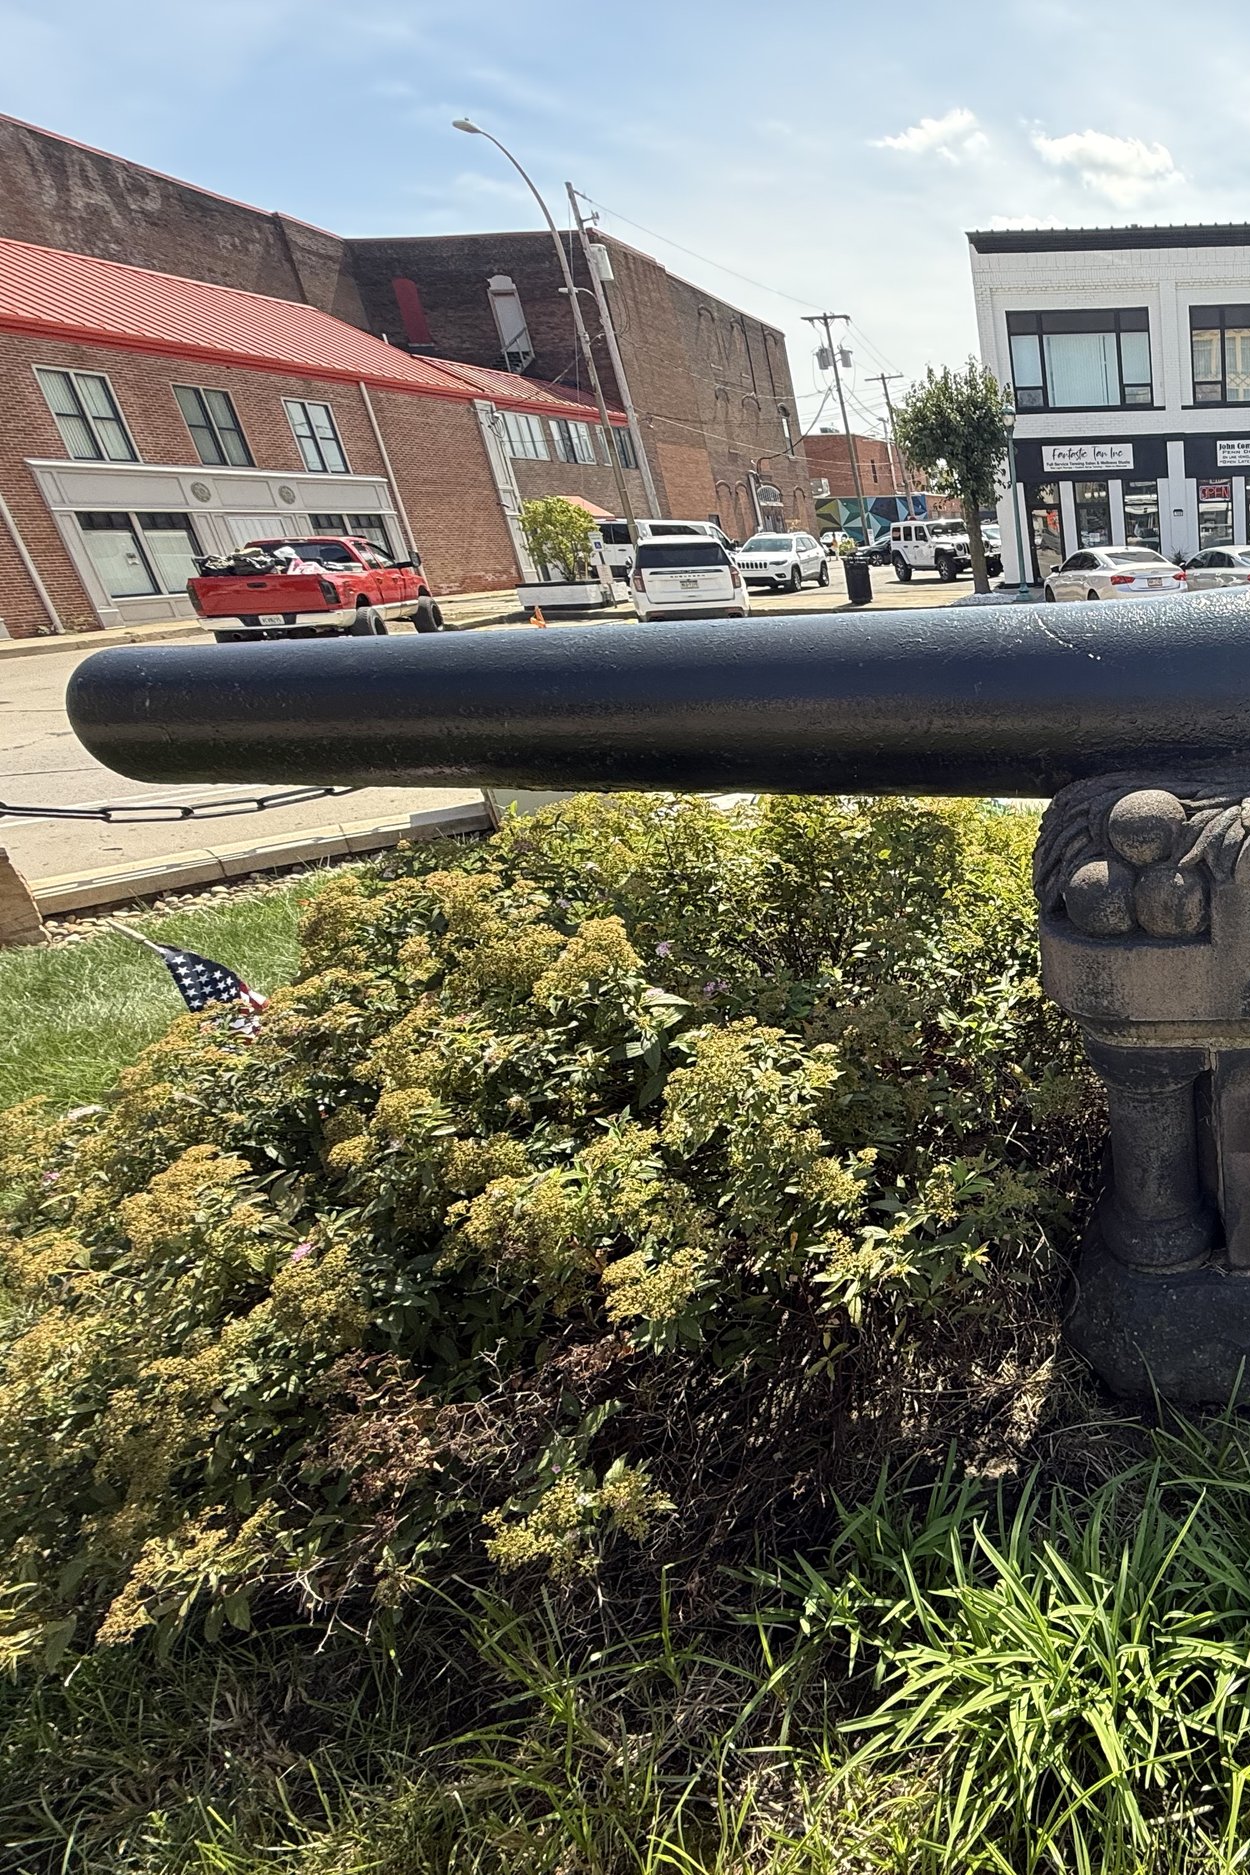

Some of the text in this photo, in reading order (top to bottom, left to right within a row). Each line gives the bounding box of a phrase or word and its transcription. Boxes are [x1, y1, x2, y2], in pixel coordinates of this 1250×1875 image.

[1052, 445, 1123, 461] Fantastic Tan Inc
[1200, 486, 1230, 500] OPEN
